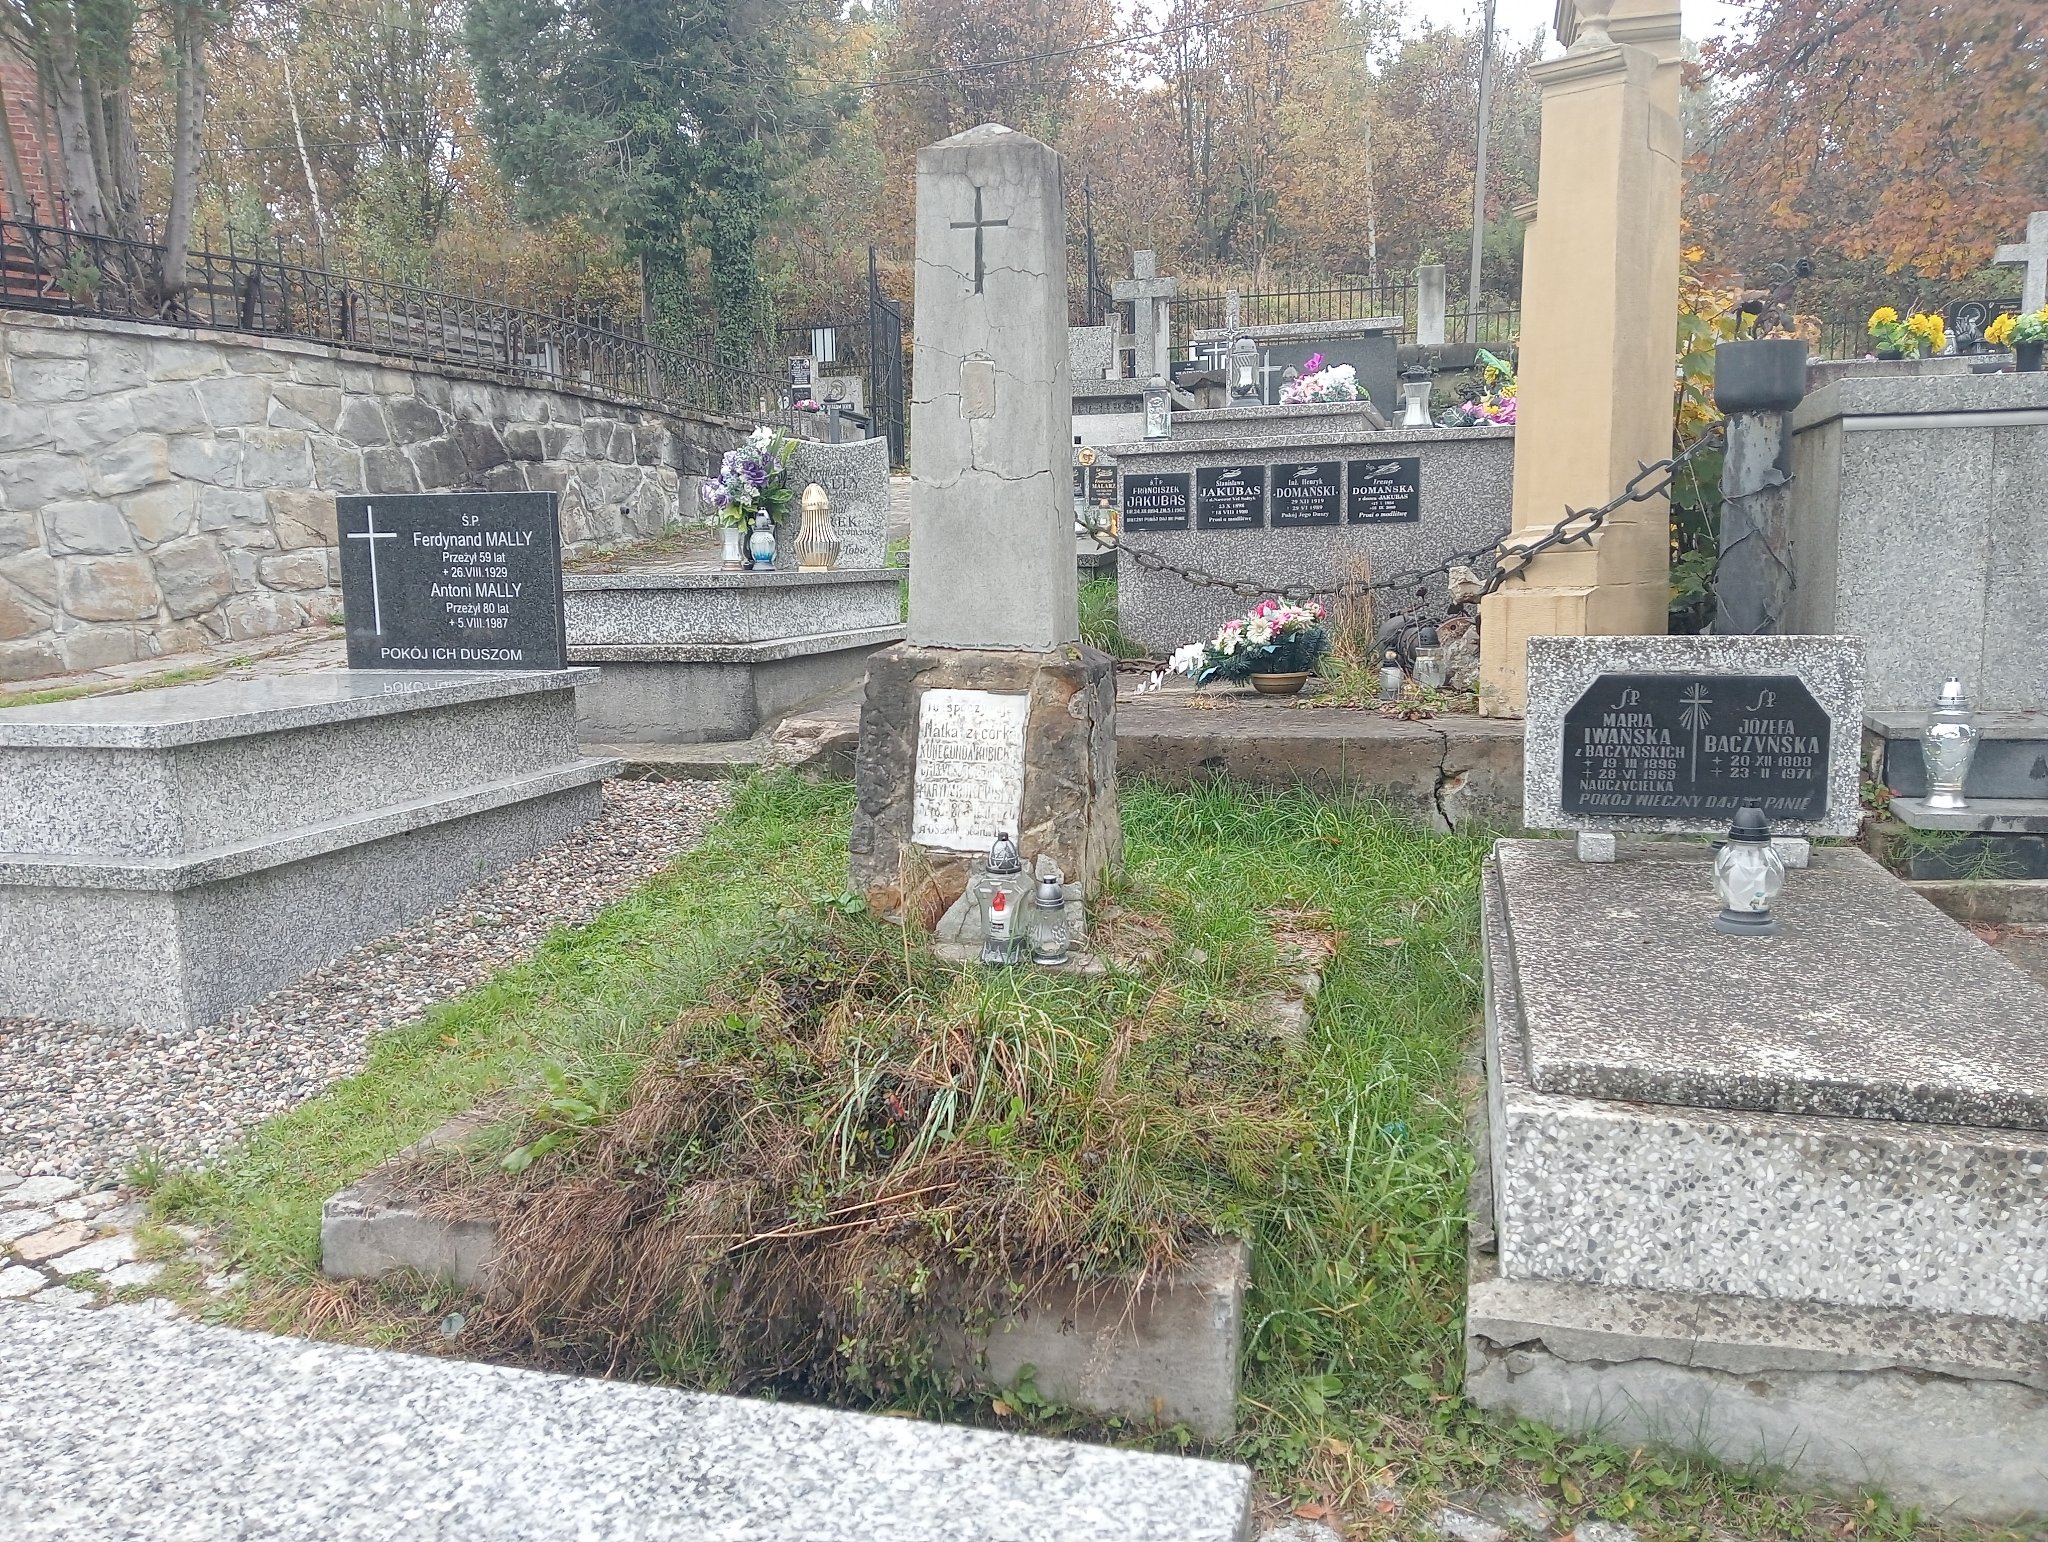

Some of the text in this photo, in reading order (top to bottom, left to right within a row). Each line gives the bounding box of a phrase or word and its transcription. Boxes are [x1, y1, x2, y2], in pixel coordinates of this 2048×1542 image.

[1301, 478, 1323, 486] Henryk
[1132, 486, 1180, 495] FRANCISZEK
[1200, 485, 1261, 497] JAKUBAS
[1126, 494, 1186, 508] JAKUBAS
[413, 530, 533, 550] Ferdynand MALLY
[442, 551, 506, 565] Przeżył 59 lat
[451, 566, 508, 578] 26.VIII.1929
[430, 582, 522, 598] Antoni MALLY
[446, 602, 510, 616] Przeżył 80 lat
[457, 617, 509, 629] 5.VIII.1987
[381, 646, 523, 661] POKÓJ ICH DUSZOM
[1603, 712, 1653, 728] MARIA
[1738, 717, 1795, 735] JÓZEFA
[1584, 727, 1671, 745] IWAŃSKA
[1585, 744, 1686, 759] BACZYŃSKICH
[1704, 735, 1820, 754] BACZYŃSKA
[1580, 779, 1674, 792] NAUCZYCIELKA
[1636, 794, 1702, 807] WIECZNY
[1705, 795, 1740, 809] DAJ
[1764, 796, 1812, 810] PANIE
